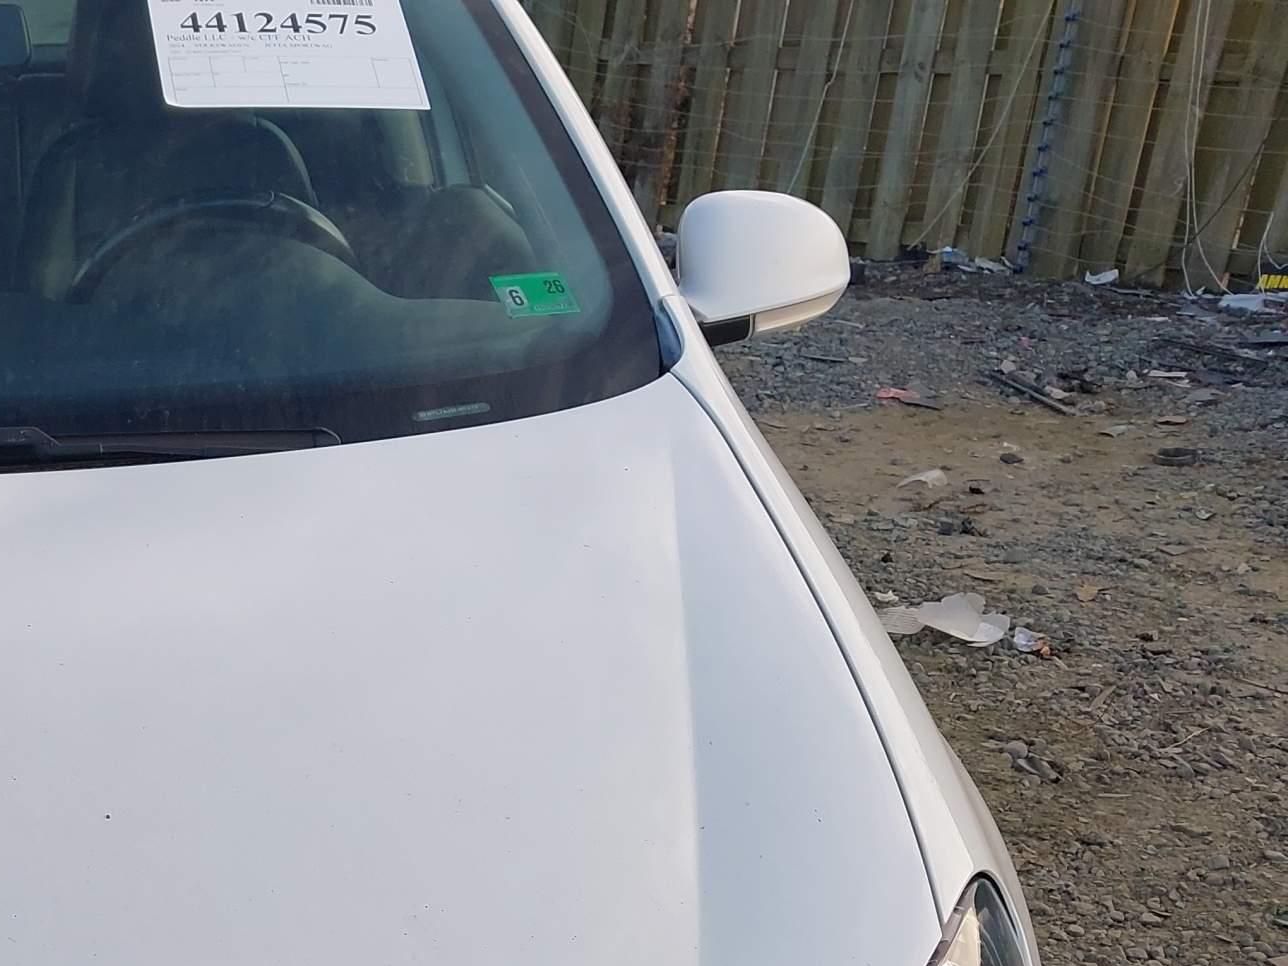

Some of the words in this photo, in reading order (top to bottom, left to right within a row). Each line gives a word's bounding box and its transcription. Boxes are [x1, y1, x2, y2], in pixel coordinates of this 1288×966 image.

[179, 11, 377, 36] 44124575
[167, 34, 201, 42] Peddle
[543, 279, 566, 294] 26
[508, 289, 525, 306] 6
